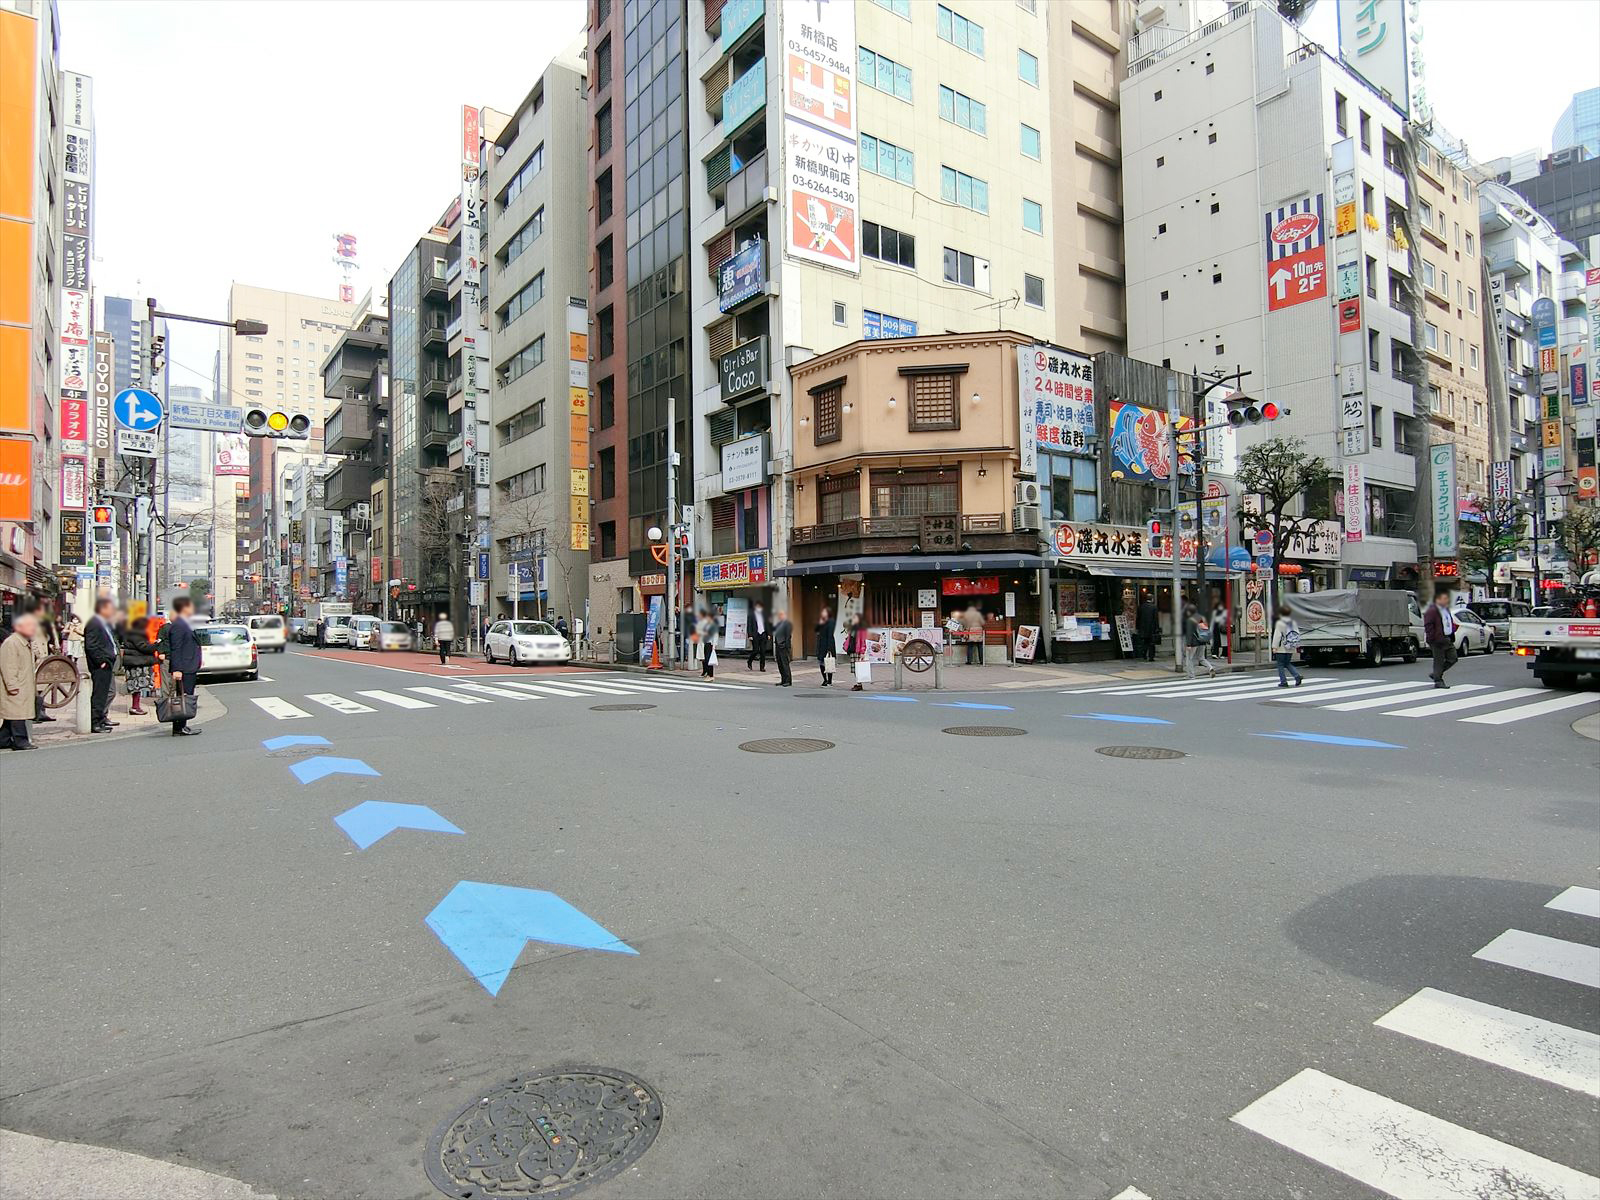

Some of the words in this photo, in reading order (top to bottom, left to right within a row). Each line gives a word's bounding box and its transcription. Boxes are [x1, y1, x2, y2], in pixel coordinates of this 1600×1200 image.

[801, 24, 838, 52] 新橋店
[788, 39, 851, 75] 03-6457-9484
[795, 155, 850, 186] 新橋駅前店
[792, 174, 855, 204] 03-6264-5430
[78, 186, 88, 229] ビリヤード
[76, 239, 86, 288] インターネット
[1298, 273, 1321, 294] 2F
[746, 350, 758, 364] Bar
[1048, 356, 1092, 382] 磯丸水産
[96, 351, 109, 393] TOYO
[67, 390, 82, 399] 4F
[1035, 376, 1094, 404] 24時間営業
[68, 402, 81, 438] カラオケ
[96, 396, 109, 449] DENSO
[173, 404, 240, 420] 新橋三丁目交番前
[209, 419, 227, 427] Police
[1036, 424, 1084, 448] 鮮度抜群
[1437, 470, 1452, 547] チェックイン新橋
[1077, 528, 1142, 558] 磯丸水産
[703, 562, 747, 582] 無料案内所
[752, 557, 762, 569] 1F
